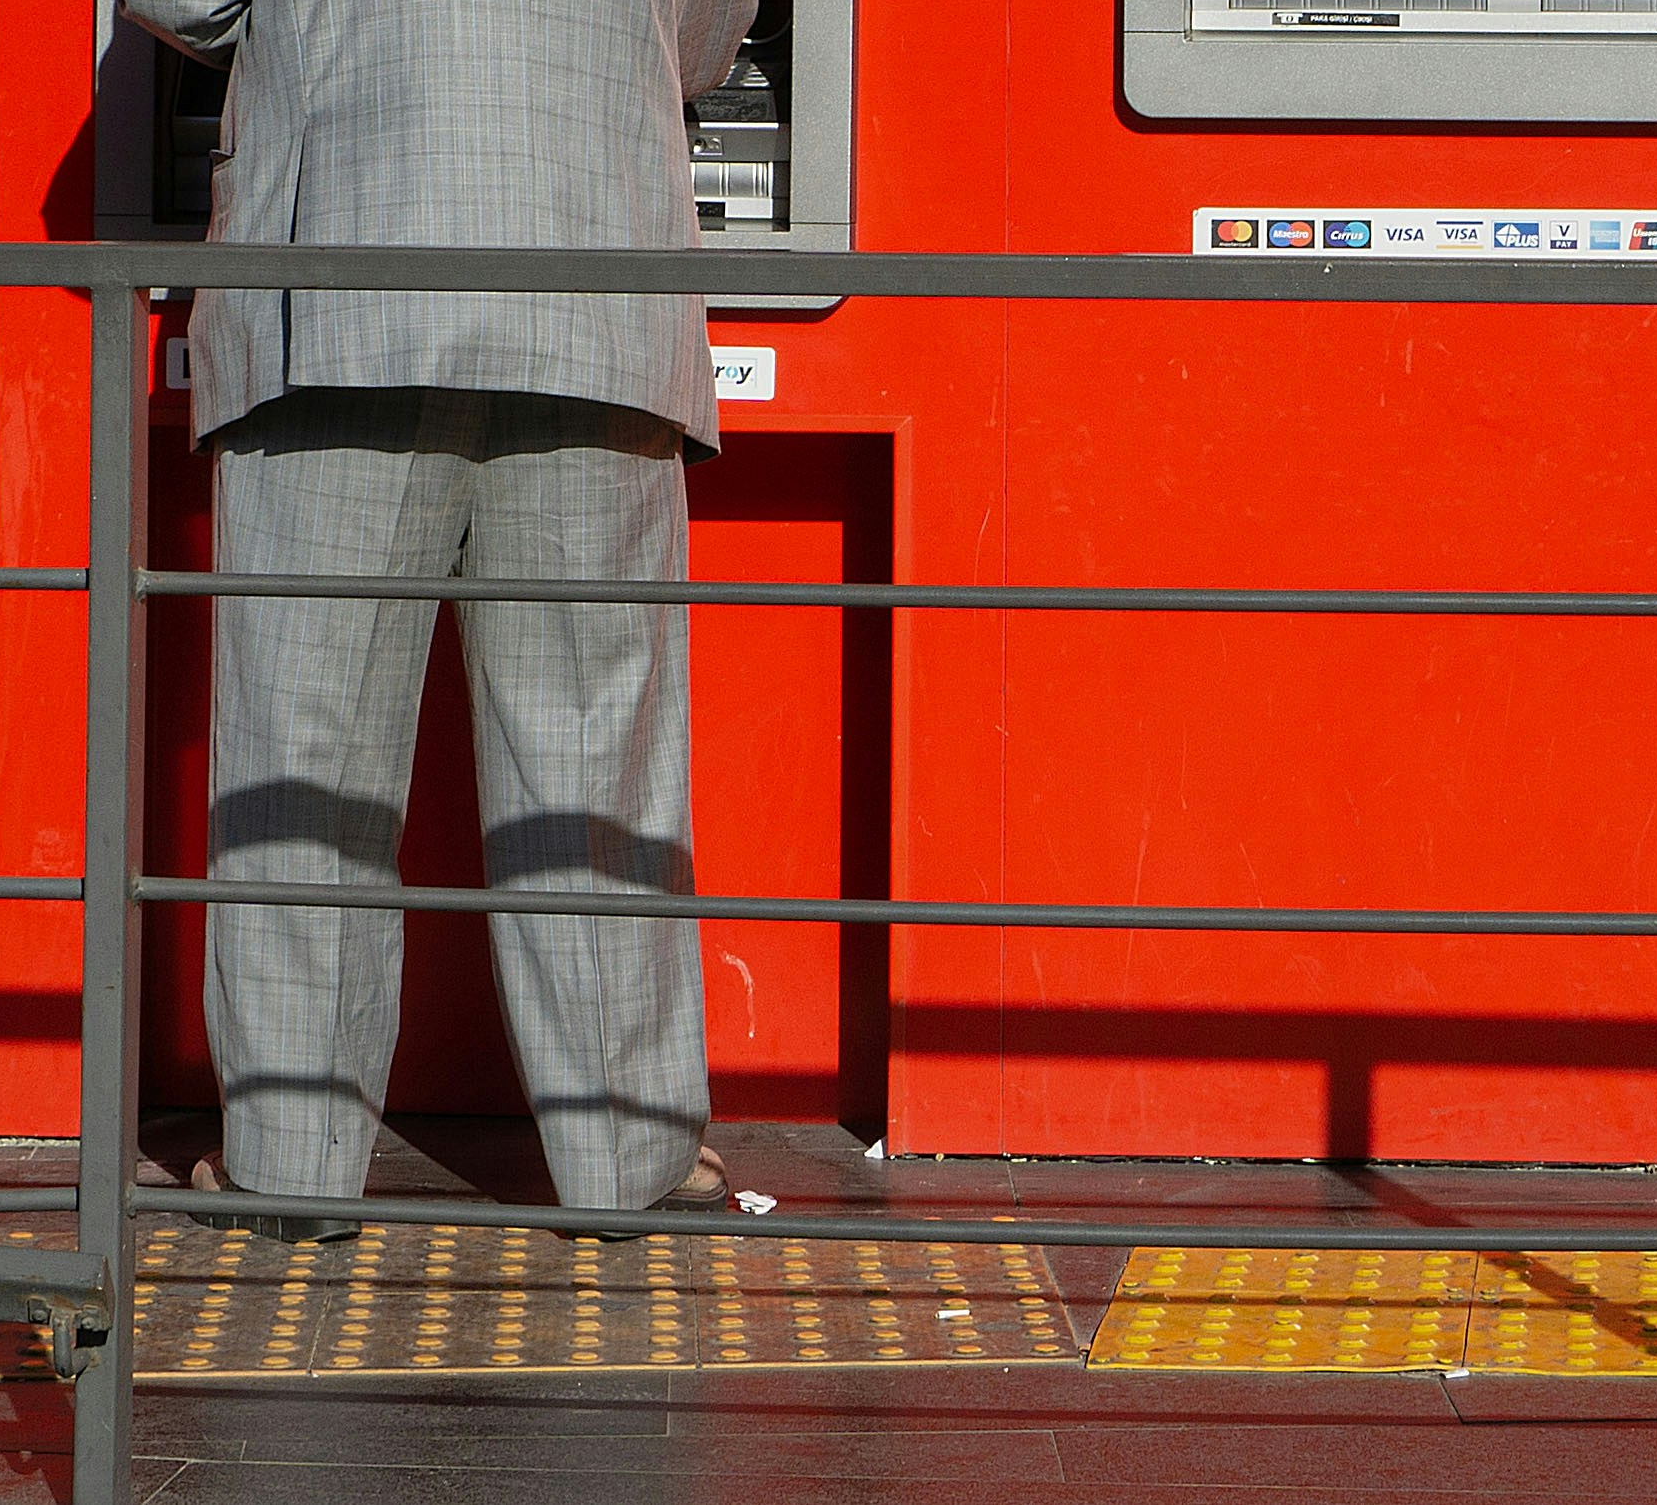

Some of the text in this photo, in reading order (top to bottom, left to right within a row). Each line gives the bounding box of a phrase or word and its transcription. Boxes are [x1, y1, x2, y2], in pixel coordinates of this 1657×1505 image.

[1273, 229, 1309, 239] Maestro
[1330, 229, 1364, 241] Cirrus
[1384, 228, 1424, 241] VISA
[1442, 228, 1478, 240] VISA
[1507, 234, 1539, 247] PLUS
[713, 365, 753, 385] roy
